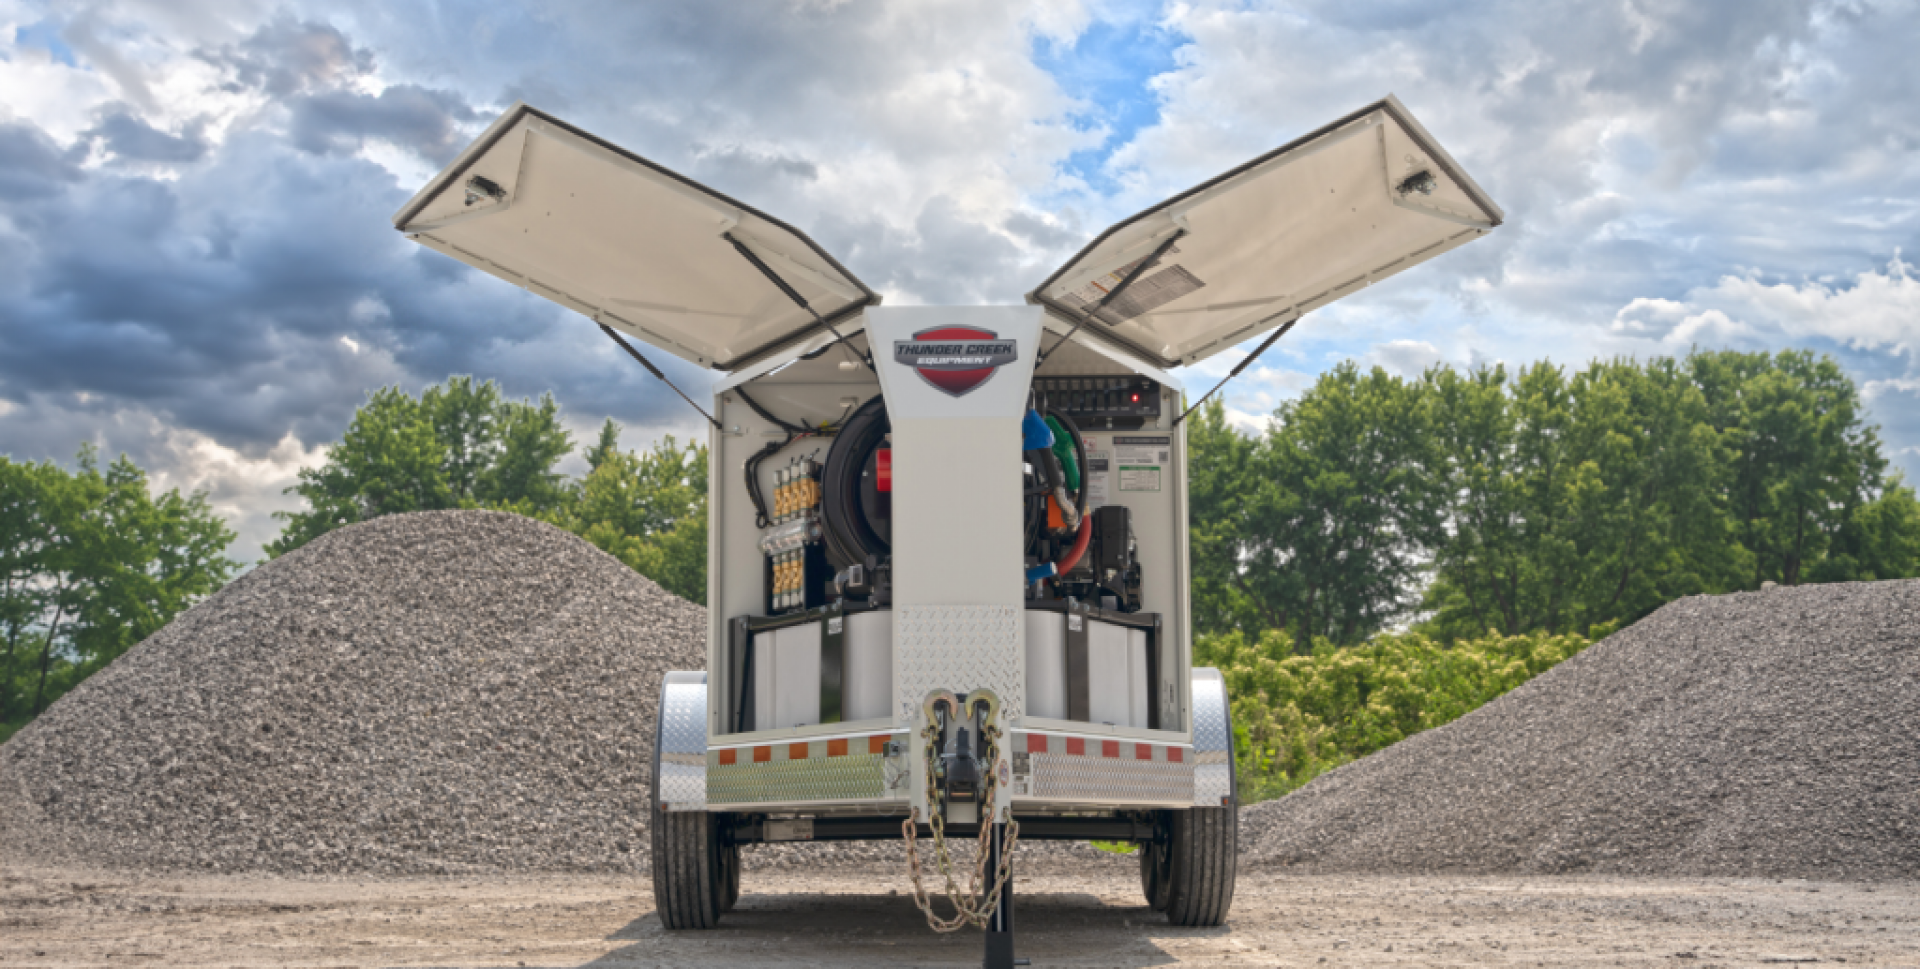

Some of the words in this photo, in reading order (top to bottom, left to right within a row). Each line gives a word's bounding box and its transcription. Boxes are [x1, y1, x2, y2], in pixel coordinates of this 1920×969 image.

[897, 344, 964, 355] THUNDER
[965, 344, 1013, 355] CREEK
[916, 356, 993, 365] EQUIPMENT
